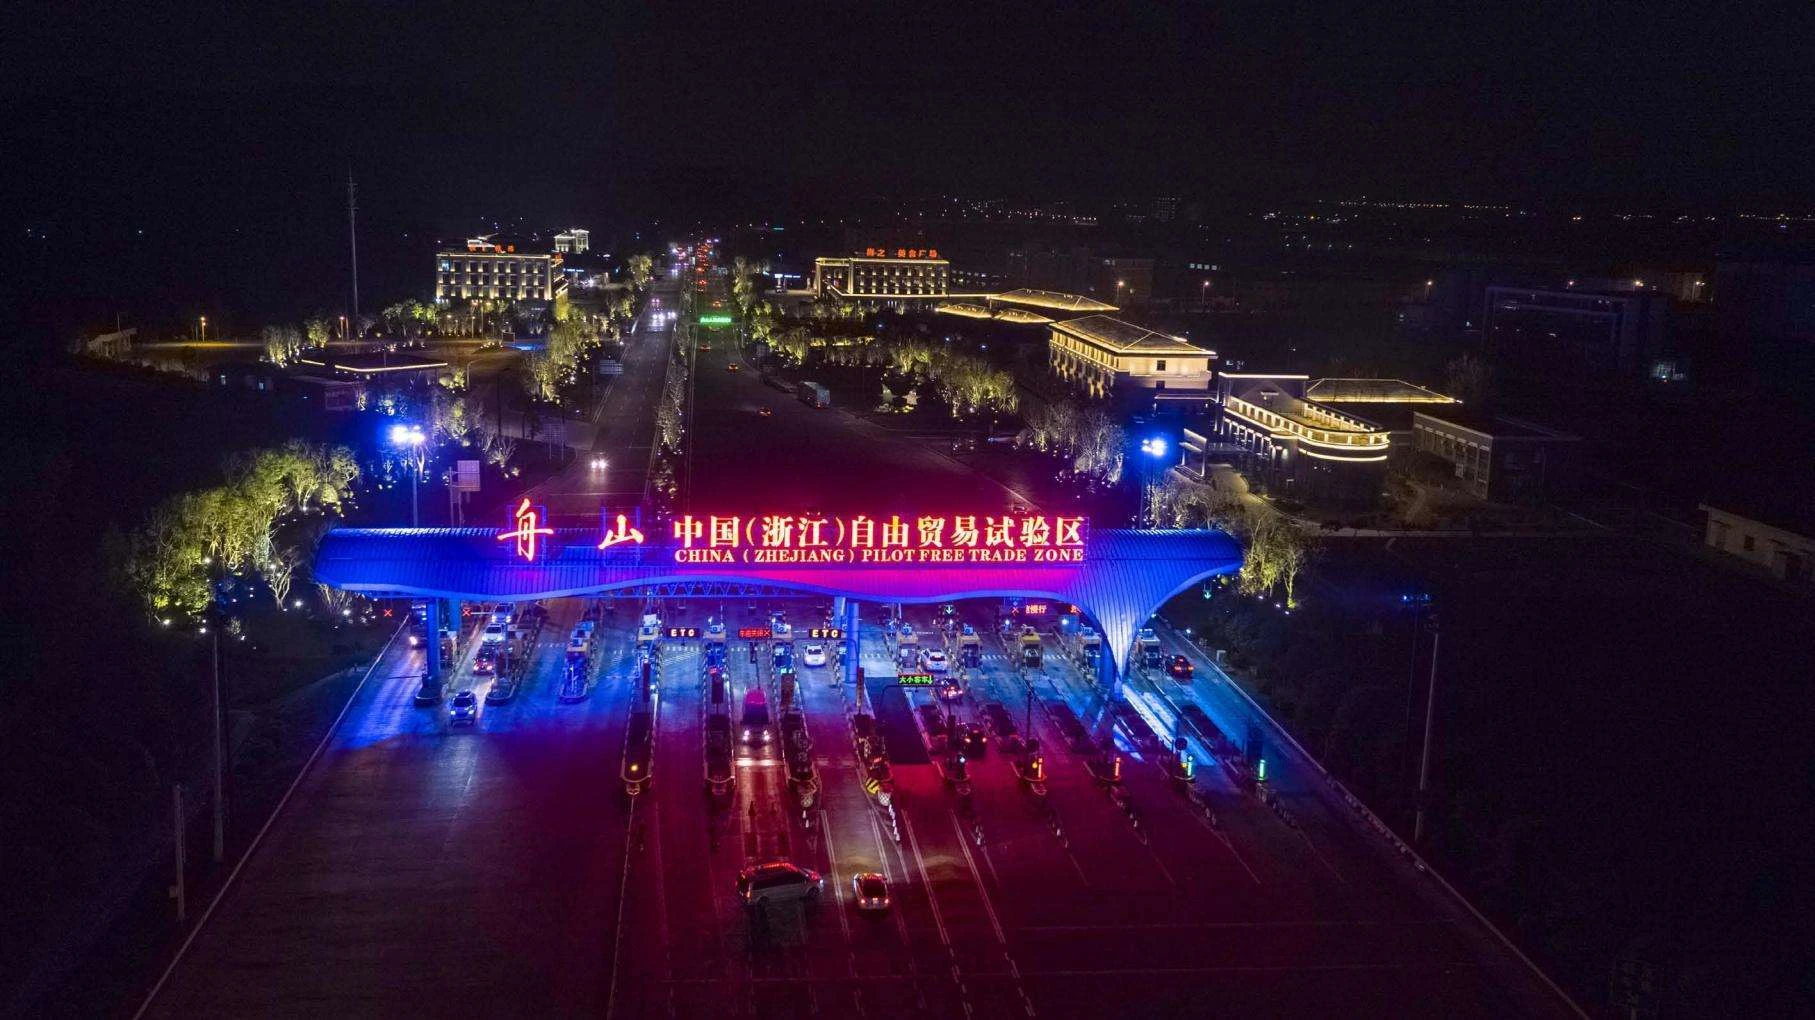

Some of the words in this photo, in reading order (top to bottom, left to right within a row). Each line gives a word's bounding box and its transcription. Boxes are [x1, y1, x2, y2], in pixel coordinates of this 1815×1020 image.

[674, 515, 1084, 548] 中国(浙江)自由贸易试验区
[674, 549, 735, 563] CHINA
[862, 549, 916, 563] PILOT
[919, 548, 965, 563] FREE
[968, 548, 1027, 562] TRADE
[1033, 548, 1085, 562] ZONE
[670, 628, 696, 638] ETC
[812, 628, 839, 639] ETC
